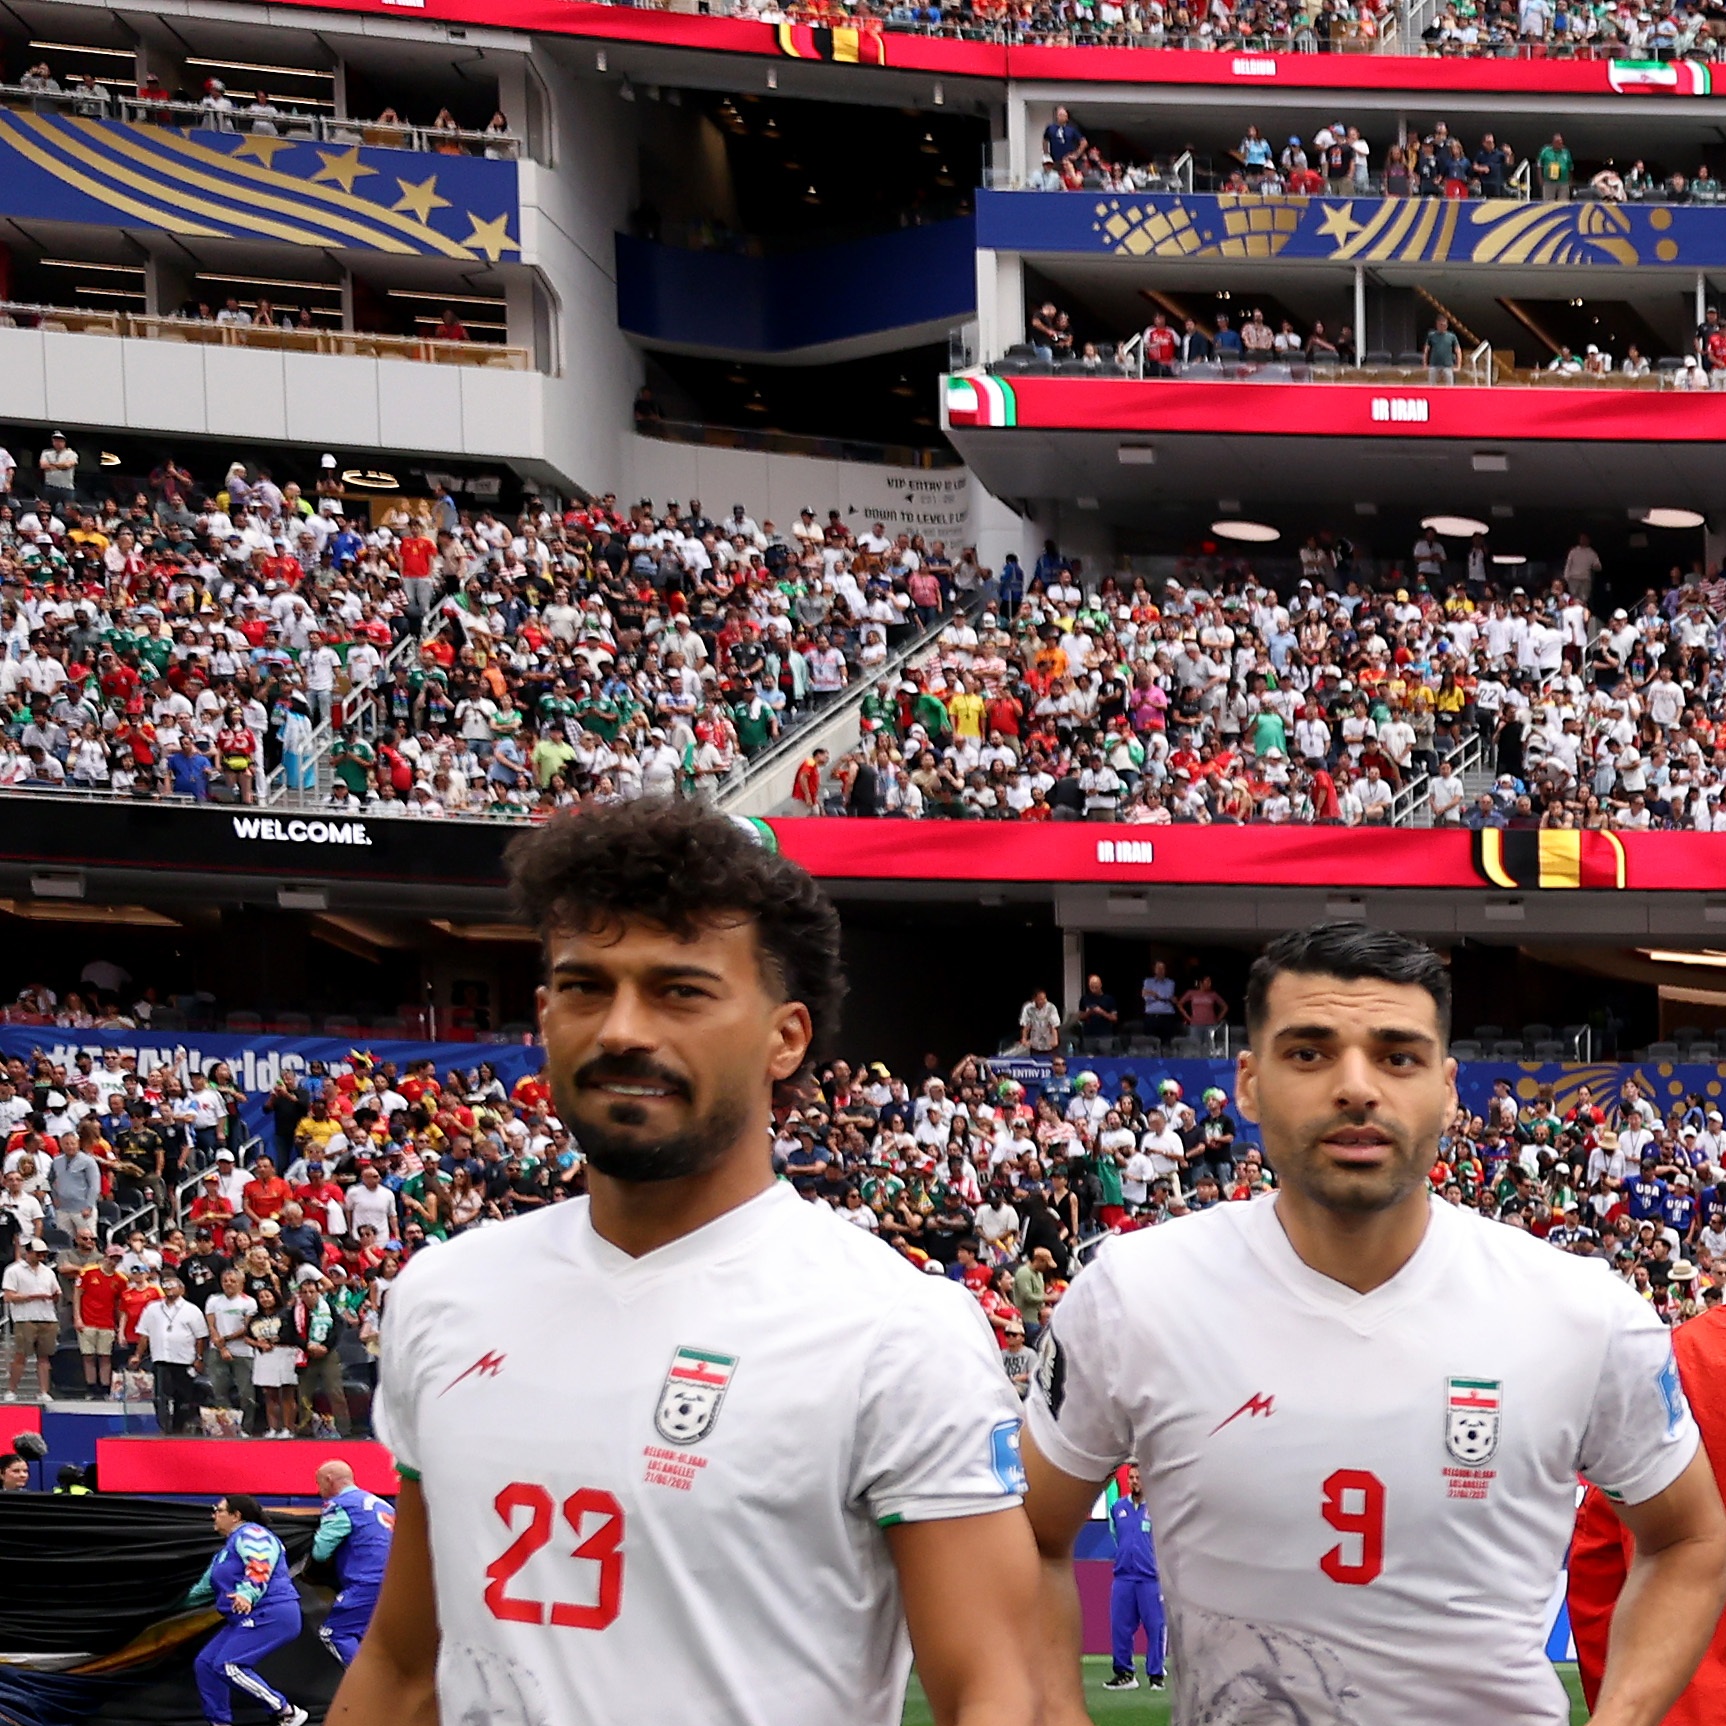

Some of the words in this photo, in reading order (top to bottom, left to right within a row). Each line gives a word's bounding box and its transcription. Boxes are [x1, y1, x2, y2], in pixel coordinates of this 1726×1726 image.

[1232, 59, 1276, 76] BELGIUM
[1372, 399, 1390, 421] IR
[1390, 399, 1429, 422] IRAN
[233, 816, 373, 846] WELCOME.
[1098, 841, 1115, 862] IR
[1115, 841, 1153, 863] IRAN
[1319, 1468, 1387, 1587] 9
[482, 1481, 625, 1632] 23
